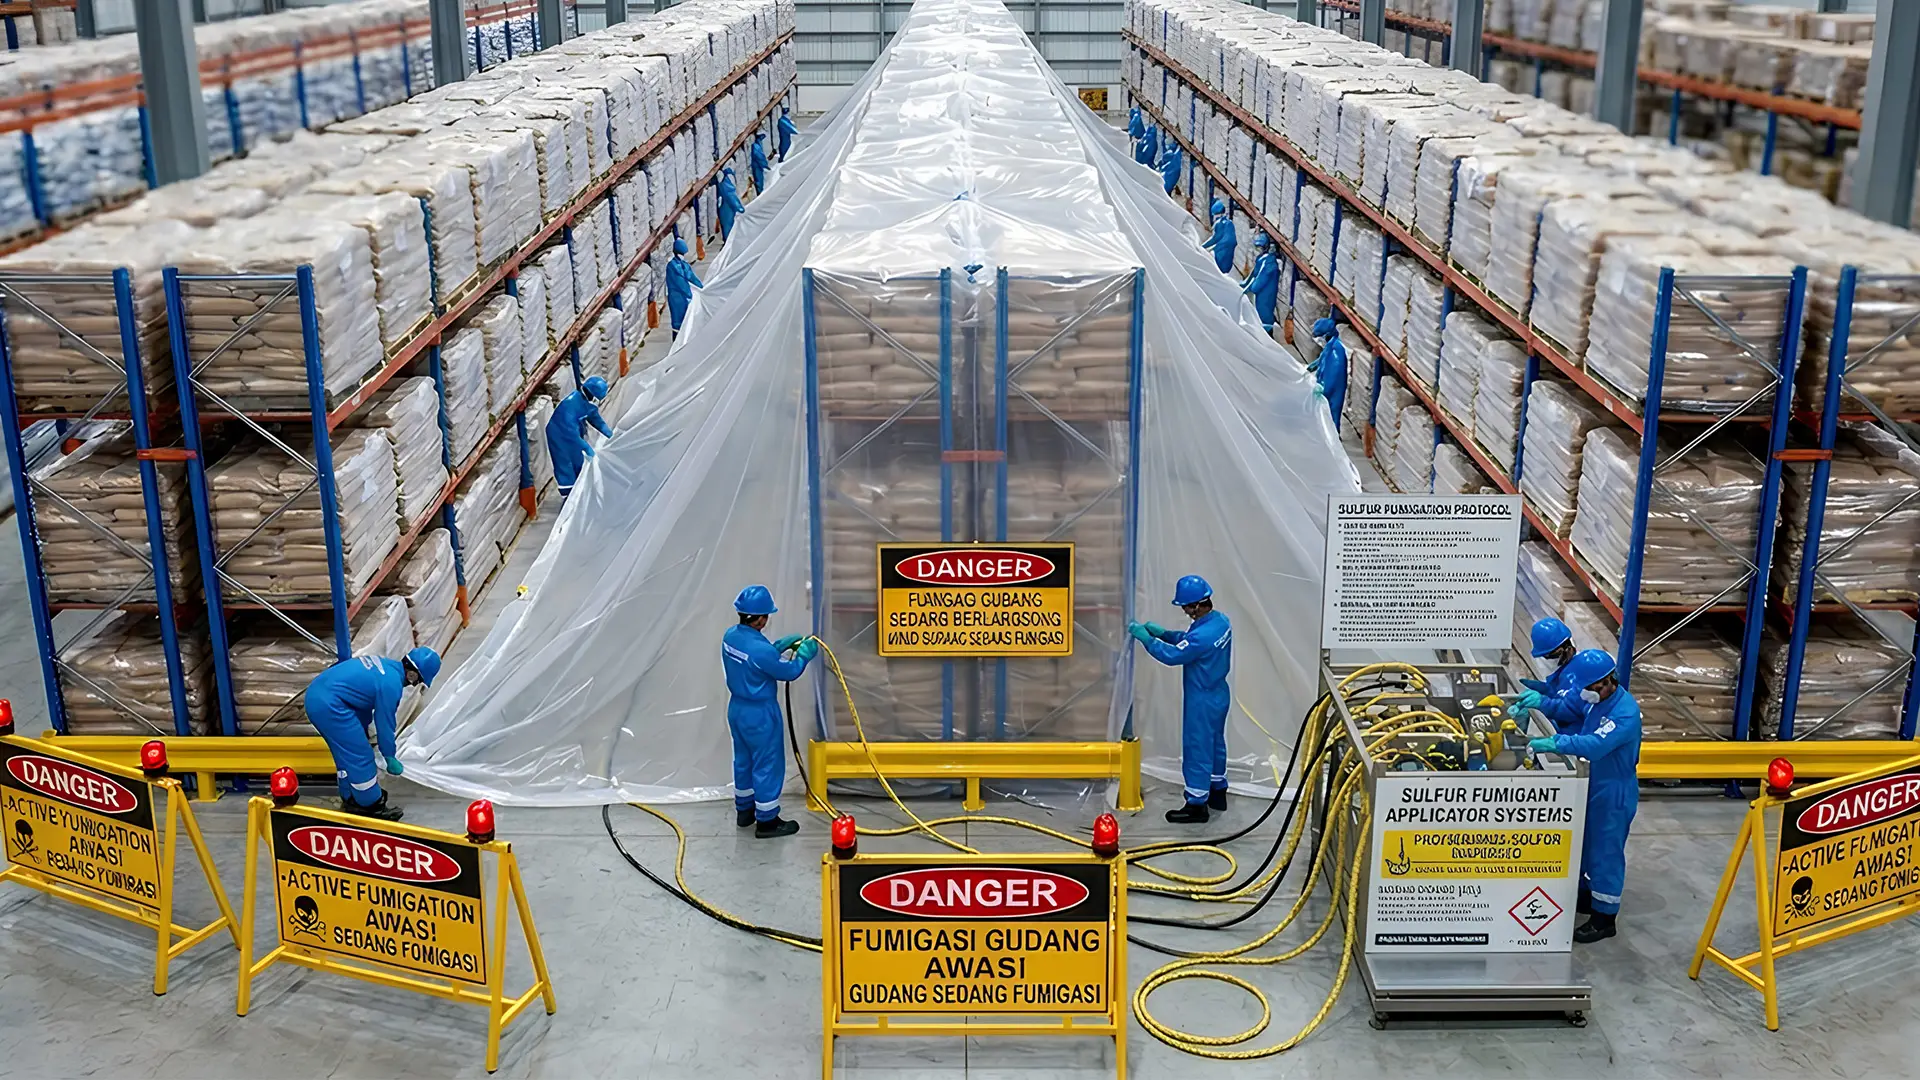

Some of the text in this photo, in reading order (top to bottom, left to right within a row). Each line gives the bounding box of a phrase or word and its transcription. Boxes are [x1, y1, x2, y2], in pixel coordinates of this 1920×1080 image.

[917, 558, 1032, 578] DANGER
[22, 760, 119, 808] DANGER
[1401, 788, 1561, 803] SULFUR FUMIGANT
[1494, 808, 1573, 822] SYSTEMS
[1816, 779, 1920, 828] DANGER
[309, 831, 436, 878] DANGER
[357, 882, 475, 924] FUMIGATION
[889, 878, 1058, 908] DANGER
[333, 926, 397, 956] SEDANG
[850, 929, 1100, 951] FUMIGASI GUDANG
[850, 984, 1100, 1004] GUDANG SEDANG FUMIGASI
